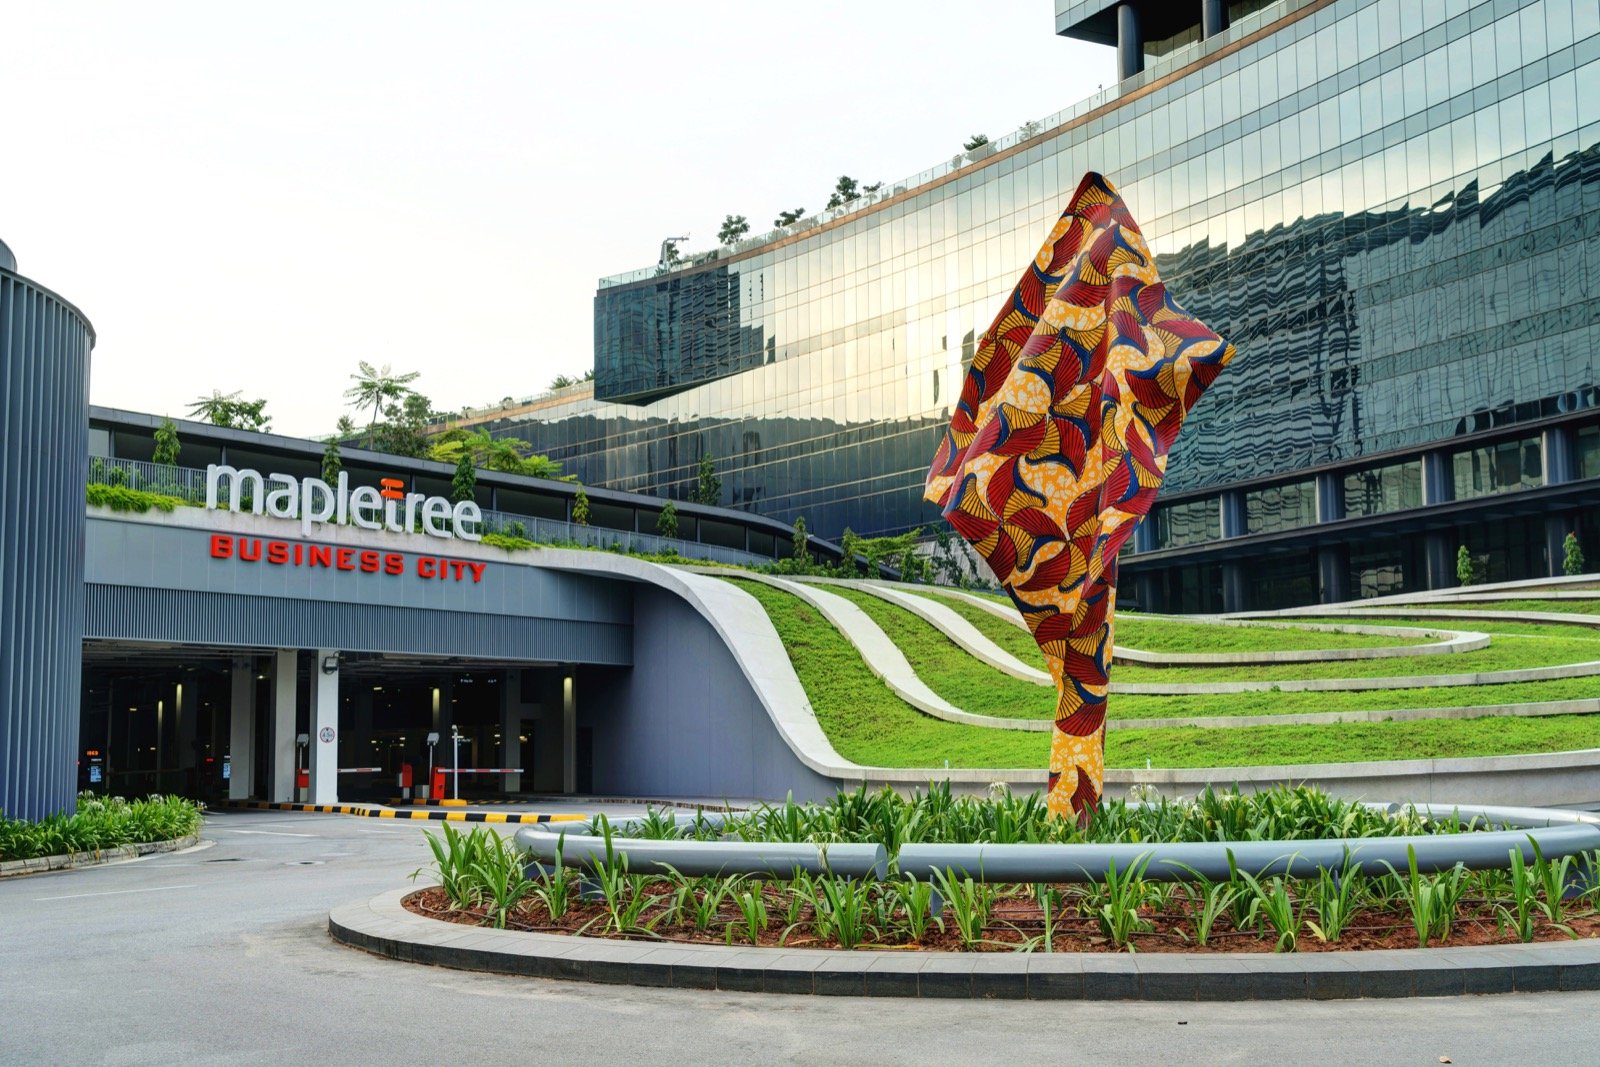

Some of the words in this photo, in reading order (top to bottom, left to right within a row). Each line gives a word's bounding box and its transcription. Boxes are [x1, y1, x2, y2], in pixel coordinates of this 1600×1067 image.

[206, 464, 482, 541] mapletree
[211, 535, 404, 575] BUSINESS
[417, 556, 487, 583] CITY
